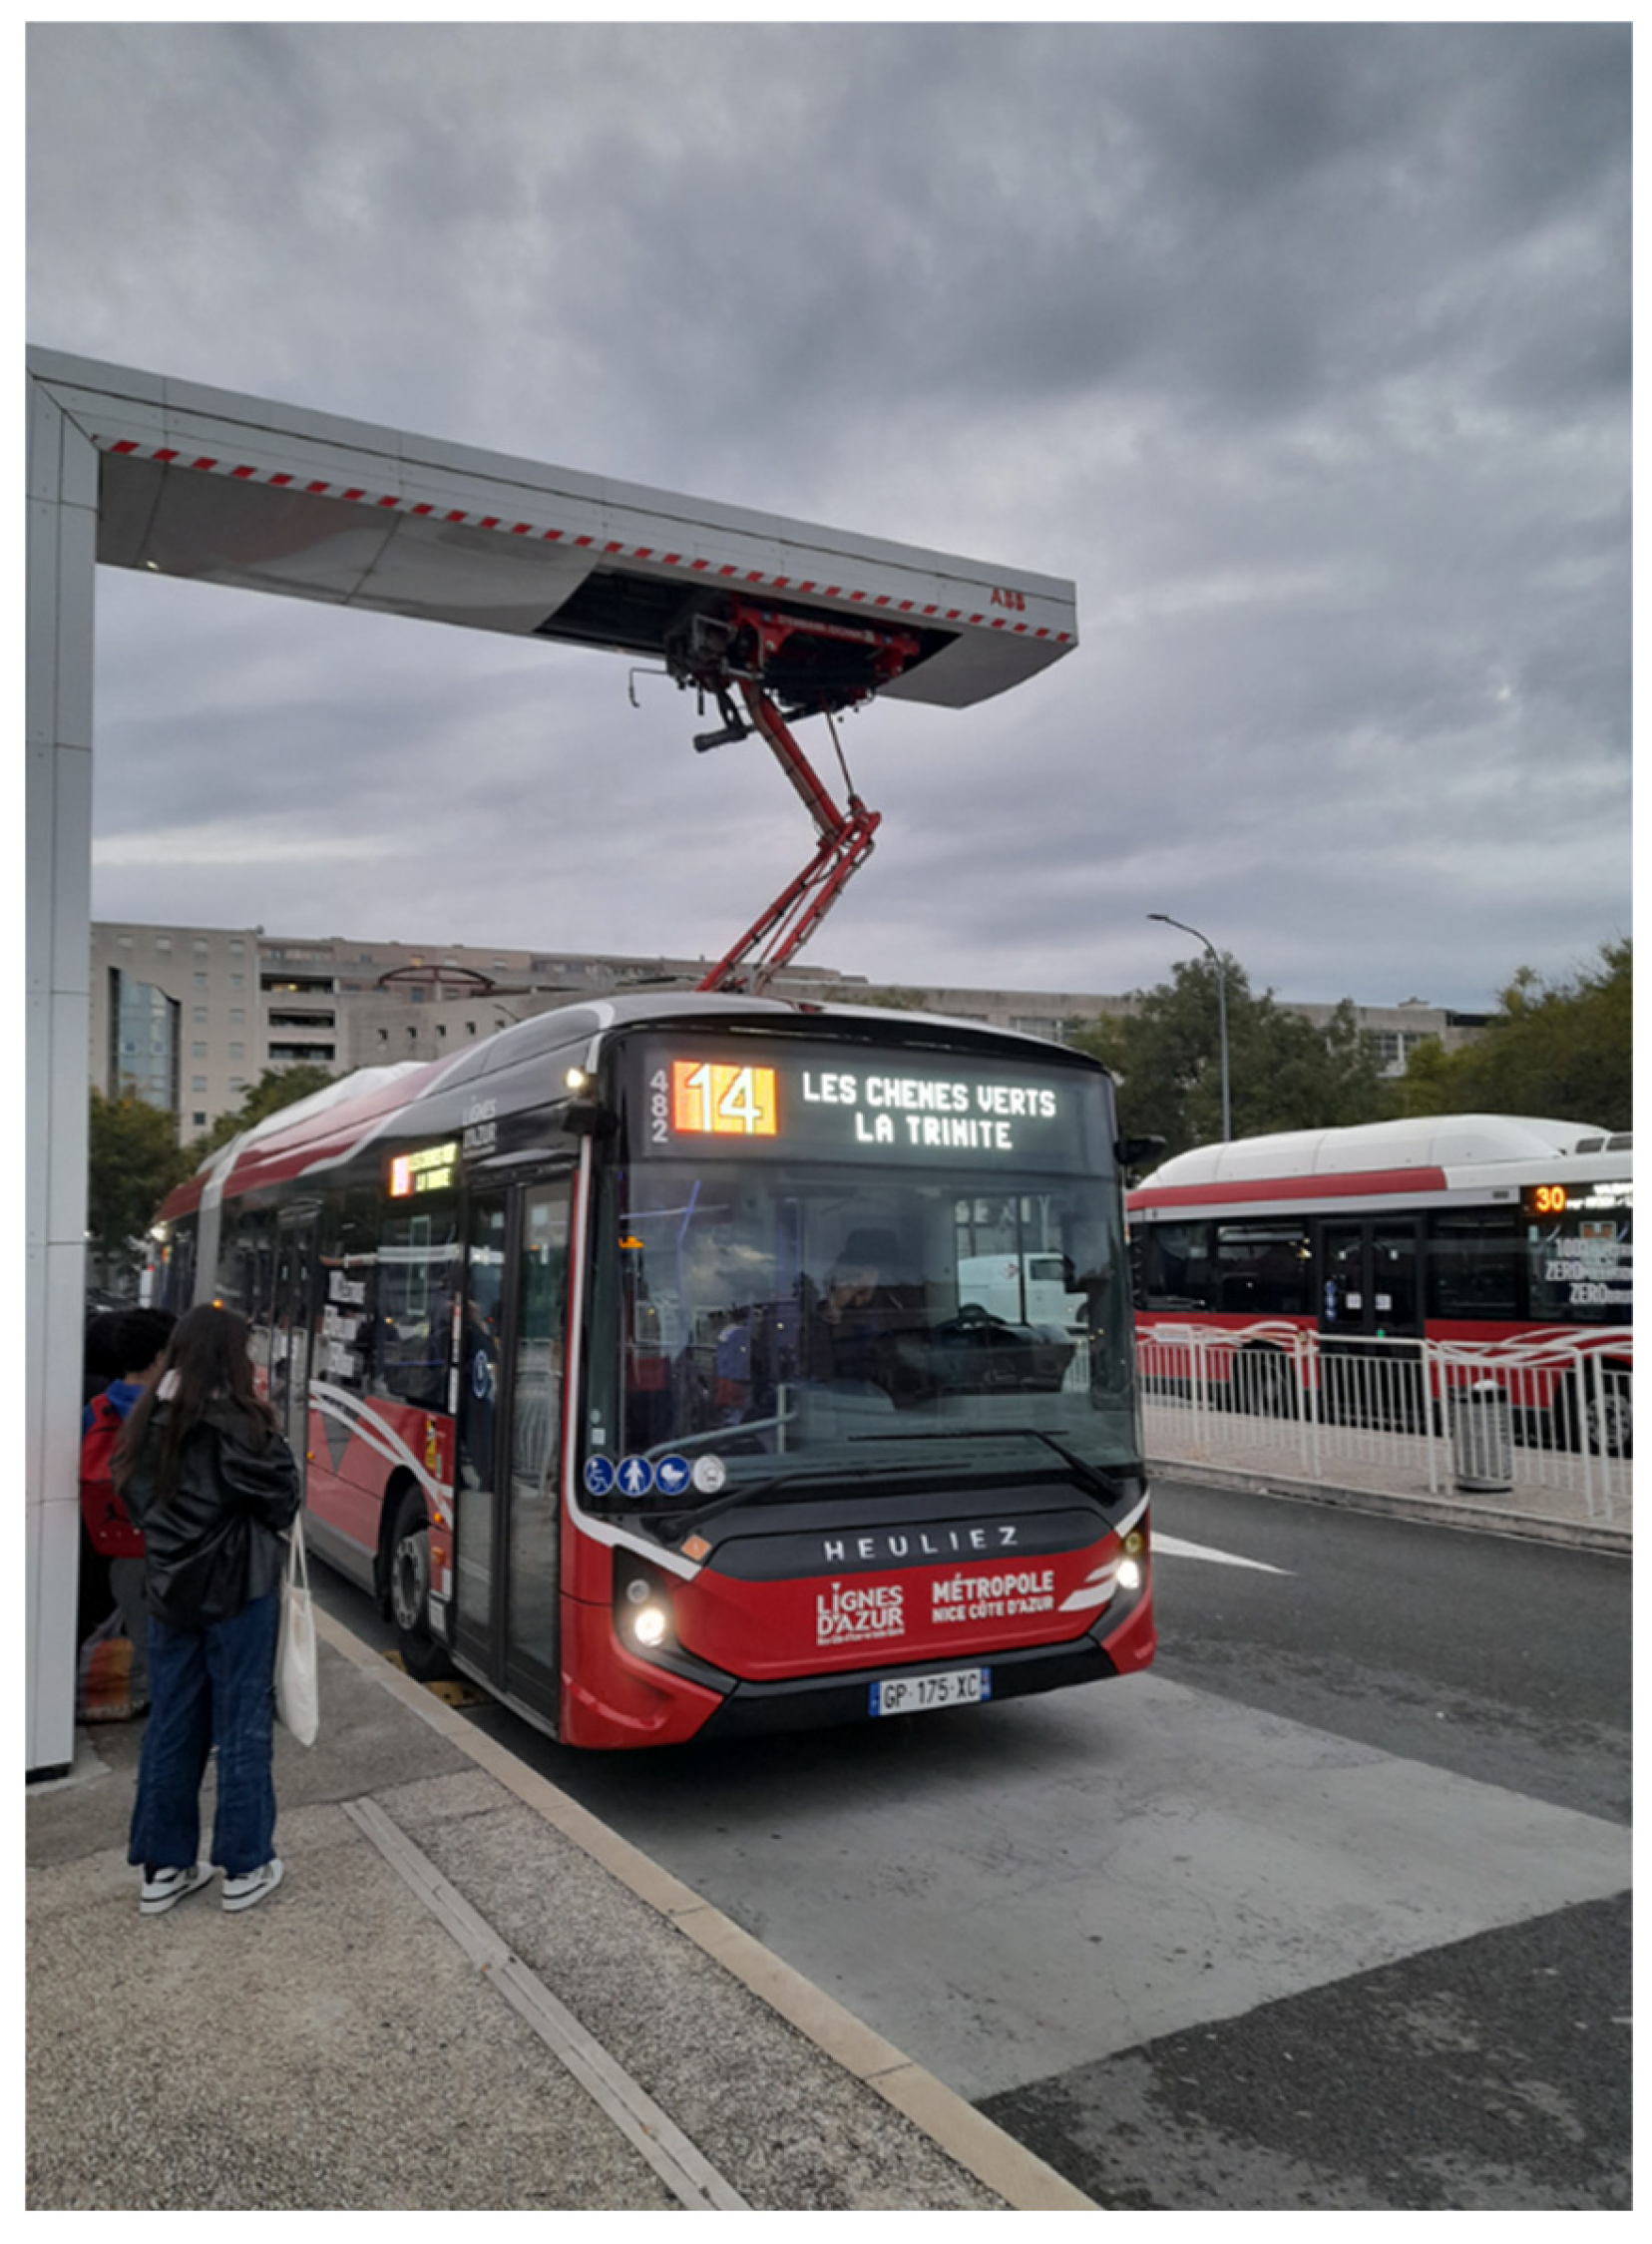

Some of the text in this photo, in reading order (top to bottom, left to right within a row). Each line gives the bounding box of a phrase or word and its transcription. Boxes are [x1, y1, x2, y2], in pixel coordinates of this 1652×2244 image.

[684, 1063, 763, 1135] 14
[802, 1071, 857, 1106] LES
[976, 1085, 1057, 1119] VERTS
[855, 1111, 1014, 1150] LA TRINITE
[1536, 1184, 1566, 1213] 30
[823, 1525, 1019, 1563] HEULIEZ
[816, 1580, 904, 1615] LIGNES
[932, 1569, 1055, 1604] MÉTROPOLE
[816, 1606, 905, 1636] D'AZUR
[932, 1604, 967, 1624] NICE
[969, 1598, 1005, 1620] CÔTE
